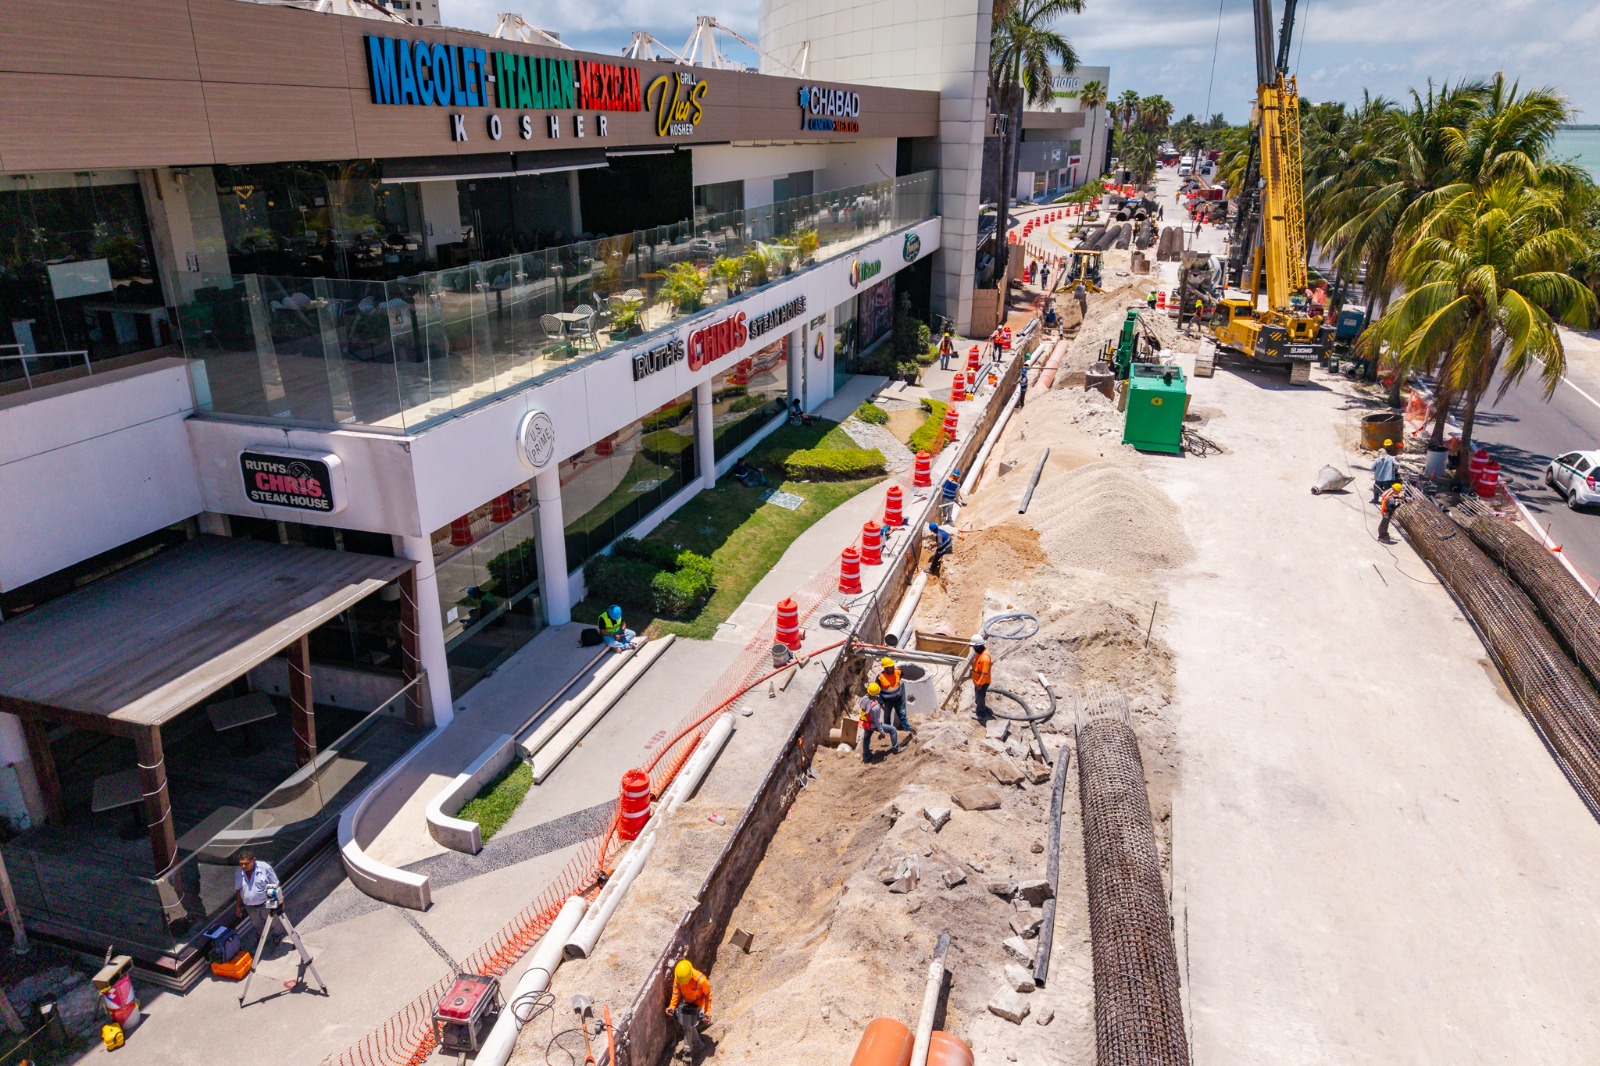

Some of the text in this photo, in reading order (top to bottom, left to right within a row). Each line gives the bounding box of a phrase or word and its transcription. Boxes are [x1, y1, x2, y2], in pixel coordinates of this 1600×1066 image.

[680, 72, 697, 86] GRILL
[810, 86, 860, 118] CHABAD
[453, 114, 609, 142] KOSHER
[670, 123, 694, 136] KOSHER
[632, 338, 686, 382] RUTH'S
[688, 310, 748, 372] CHRIS
[748, 308, 780, 341] STEAK
[779, 294, 807, 326] HOUSE
[531, 427, 552, 461] PRIME
[245, 459, 287, 474] RUTH'S
[255, 472, 323, 498] CHRIS
[251, 490, 330, 509] STEAK HOUSE
